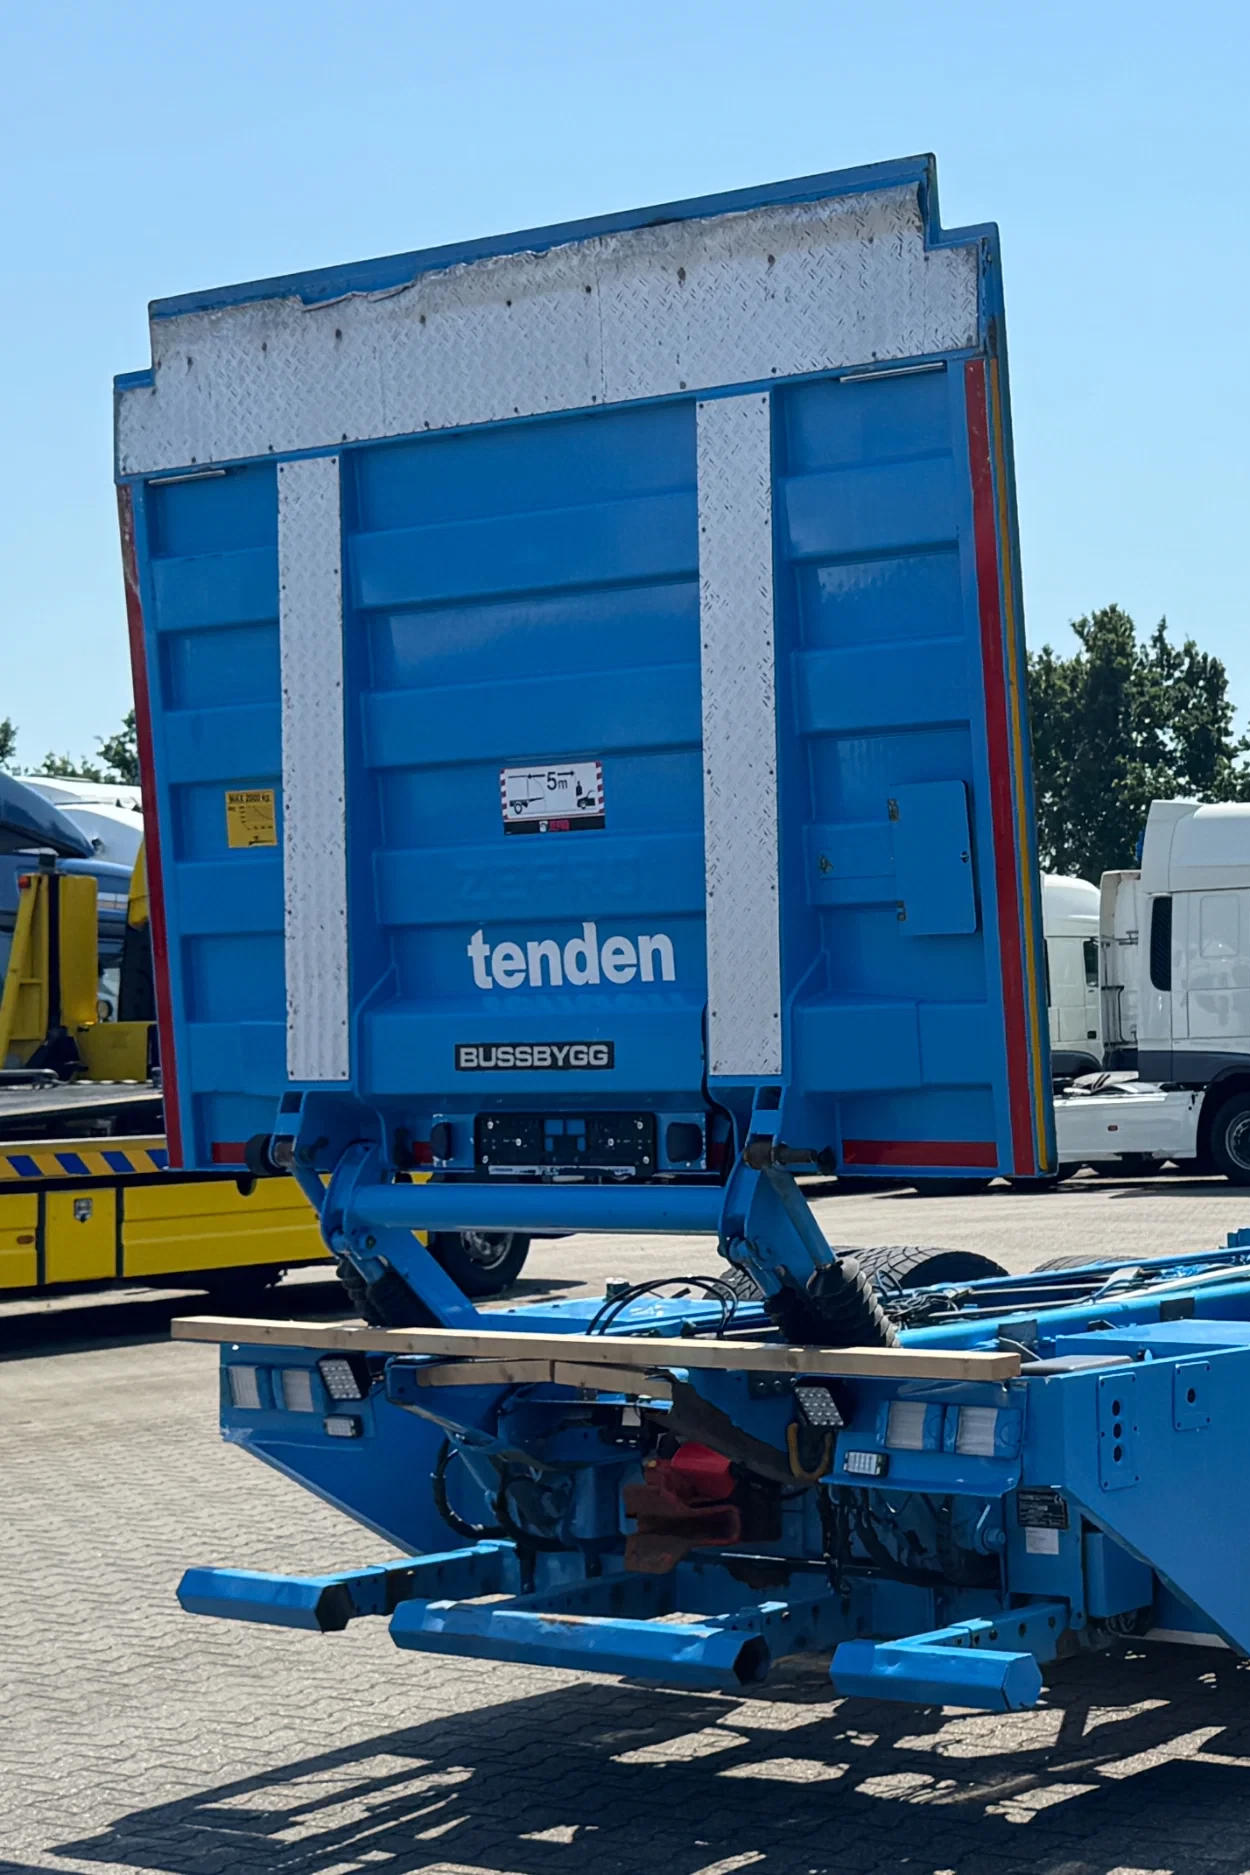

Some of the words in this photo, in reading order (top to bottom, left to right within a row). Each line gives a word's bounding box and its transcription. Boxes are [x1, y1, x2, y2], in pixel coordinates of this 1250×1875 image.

[547, 771, 568, 791] 5m
[467, 921, 676, 989] tenden
[459, 1044, 609, 1068] BUSSBYGG
